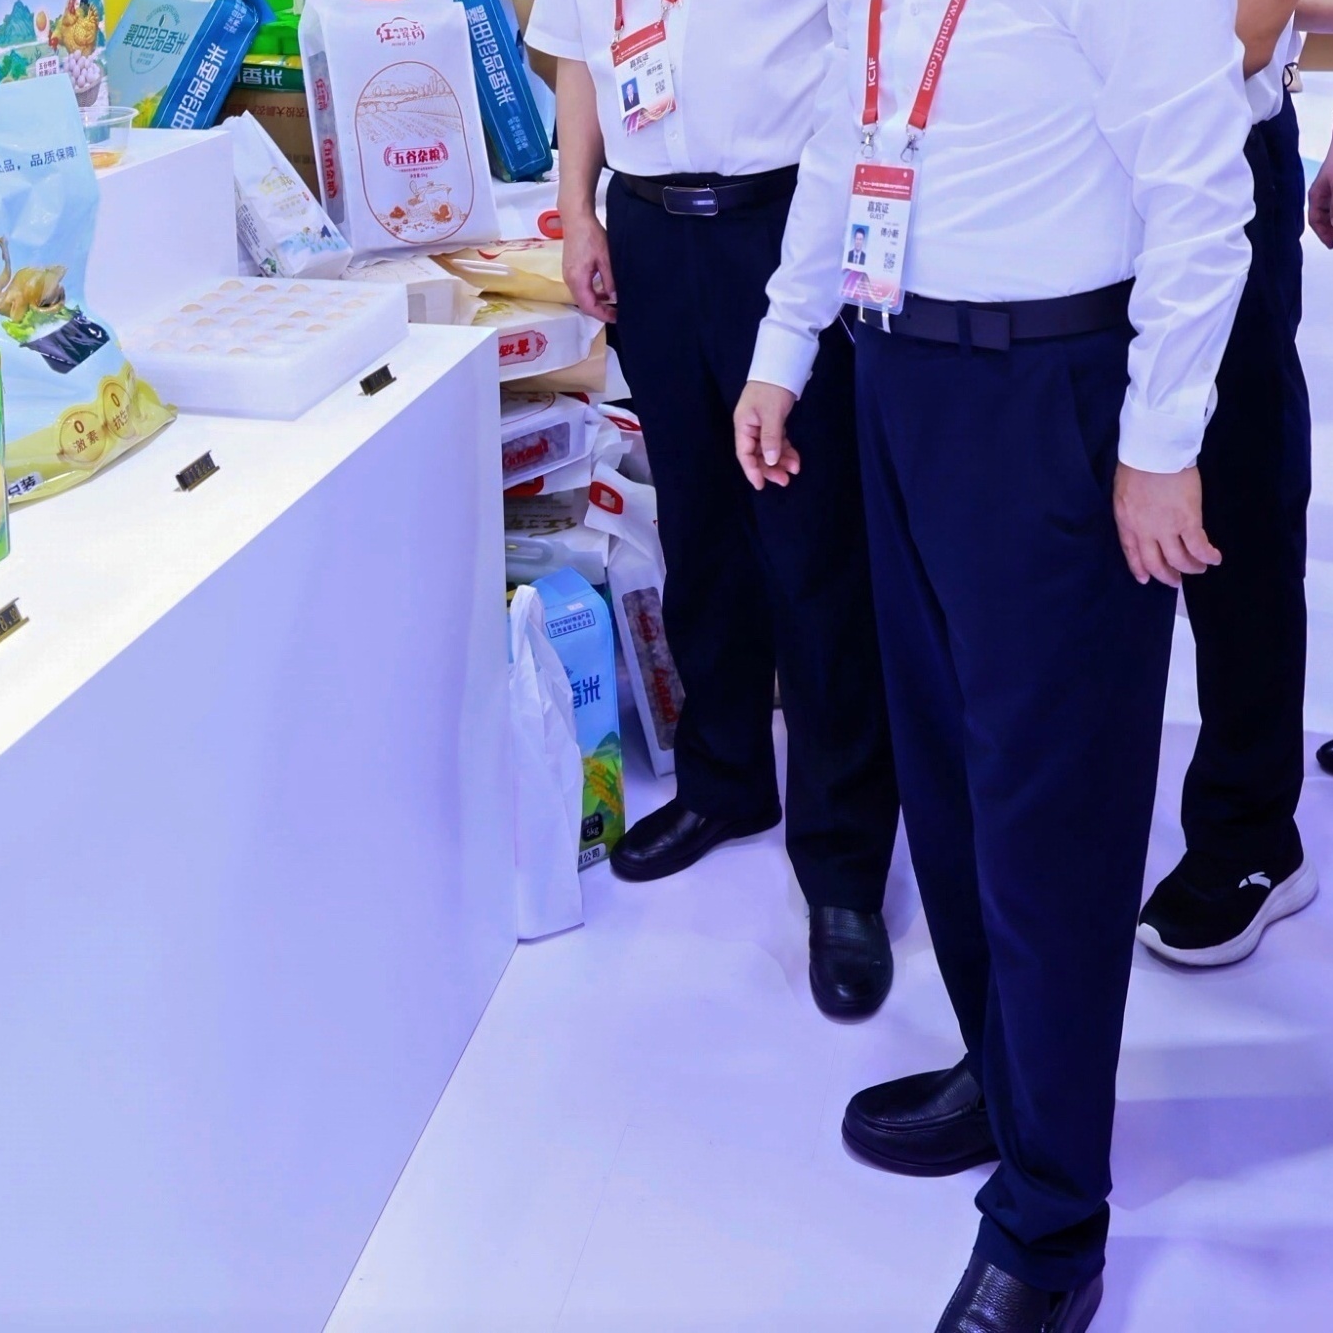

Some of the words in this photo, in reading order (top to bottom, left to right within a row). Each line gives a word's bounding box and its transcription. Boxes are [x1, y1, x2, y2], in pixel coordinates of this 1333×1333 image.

[243, 67, 283, 86] 香米
[868, 57, 876, 88] ICIF
[394, 148, 441, 165] 五谷杂粮
[868, 201, 890, 214] 嘉宾证
[72, 430, 100, 453] 激素
[586, 827, 600, 837] 5kg
